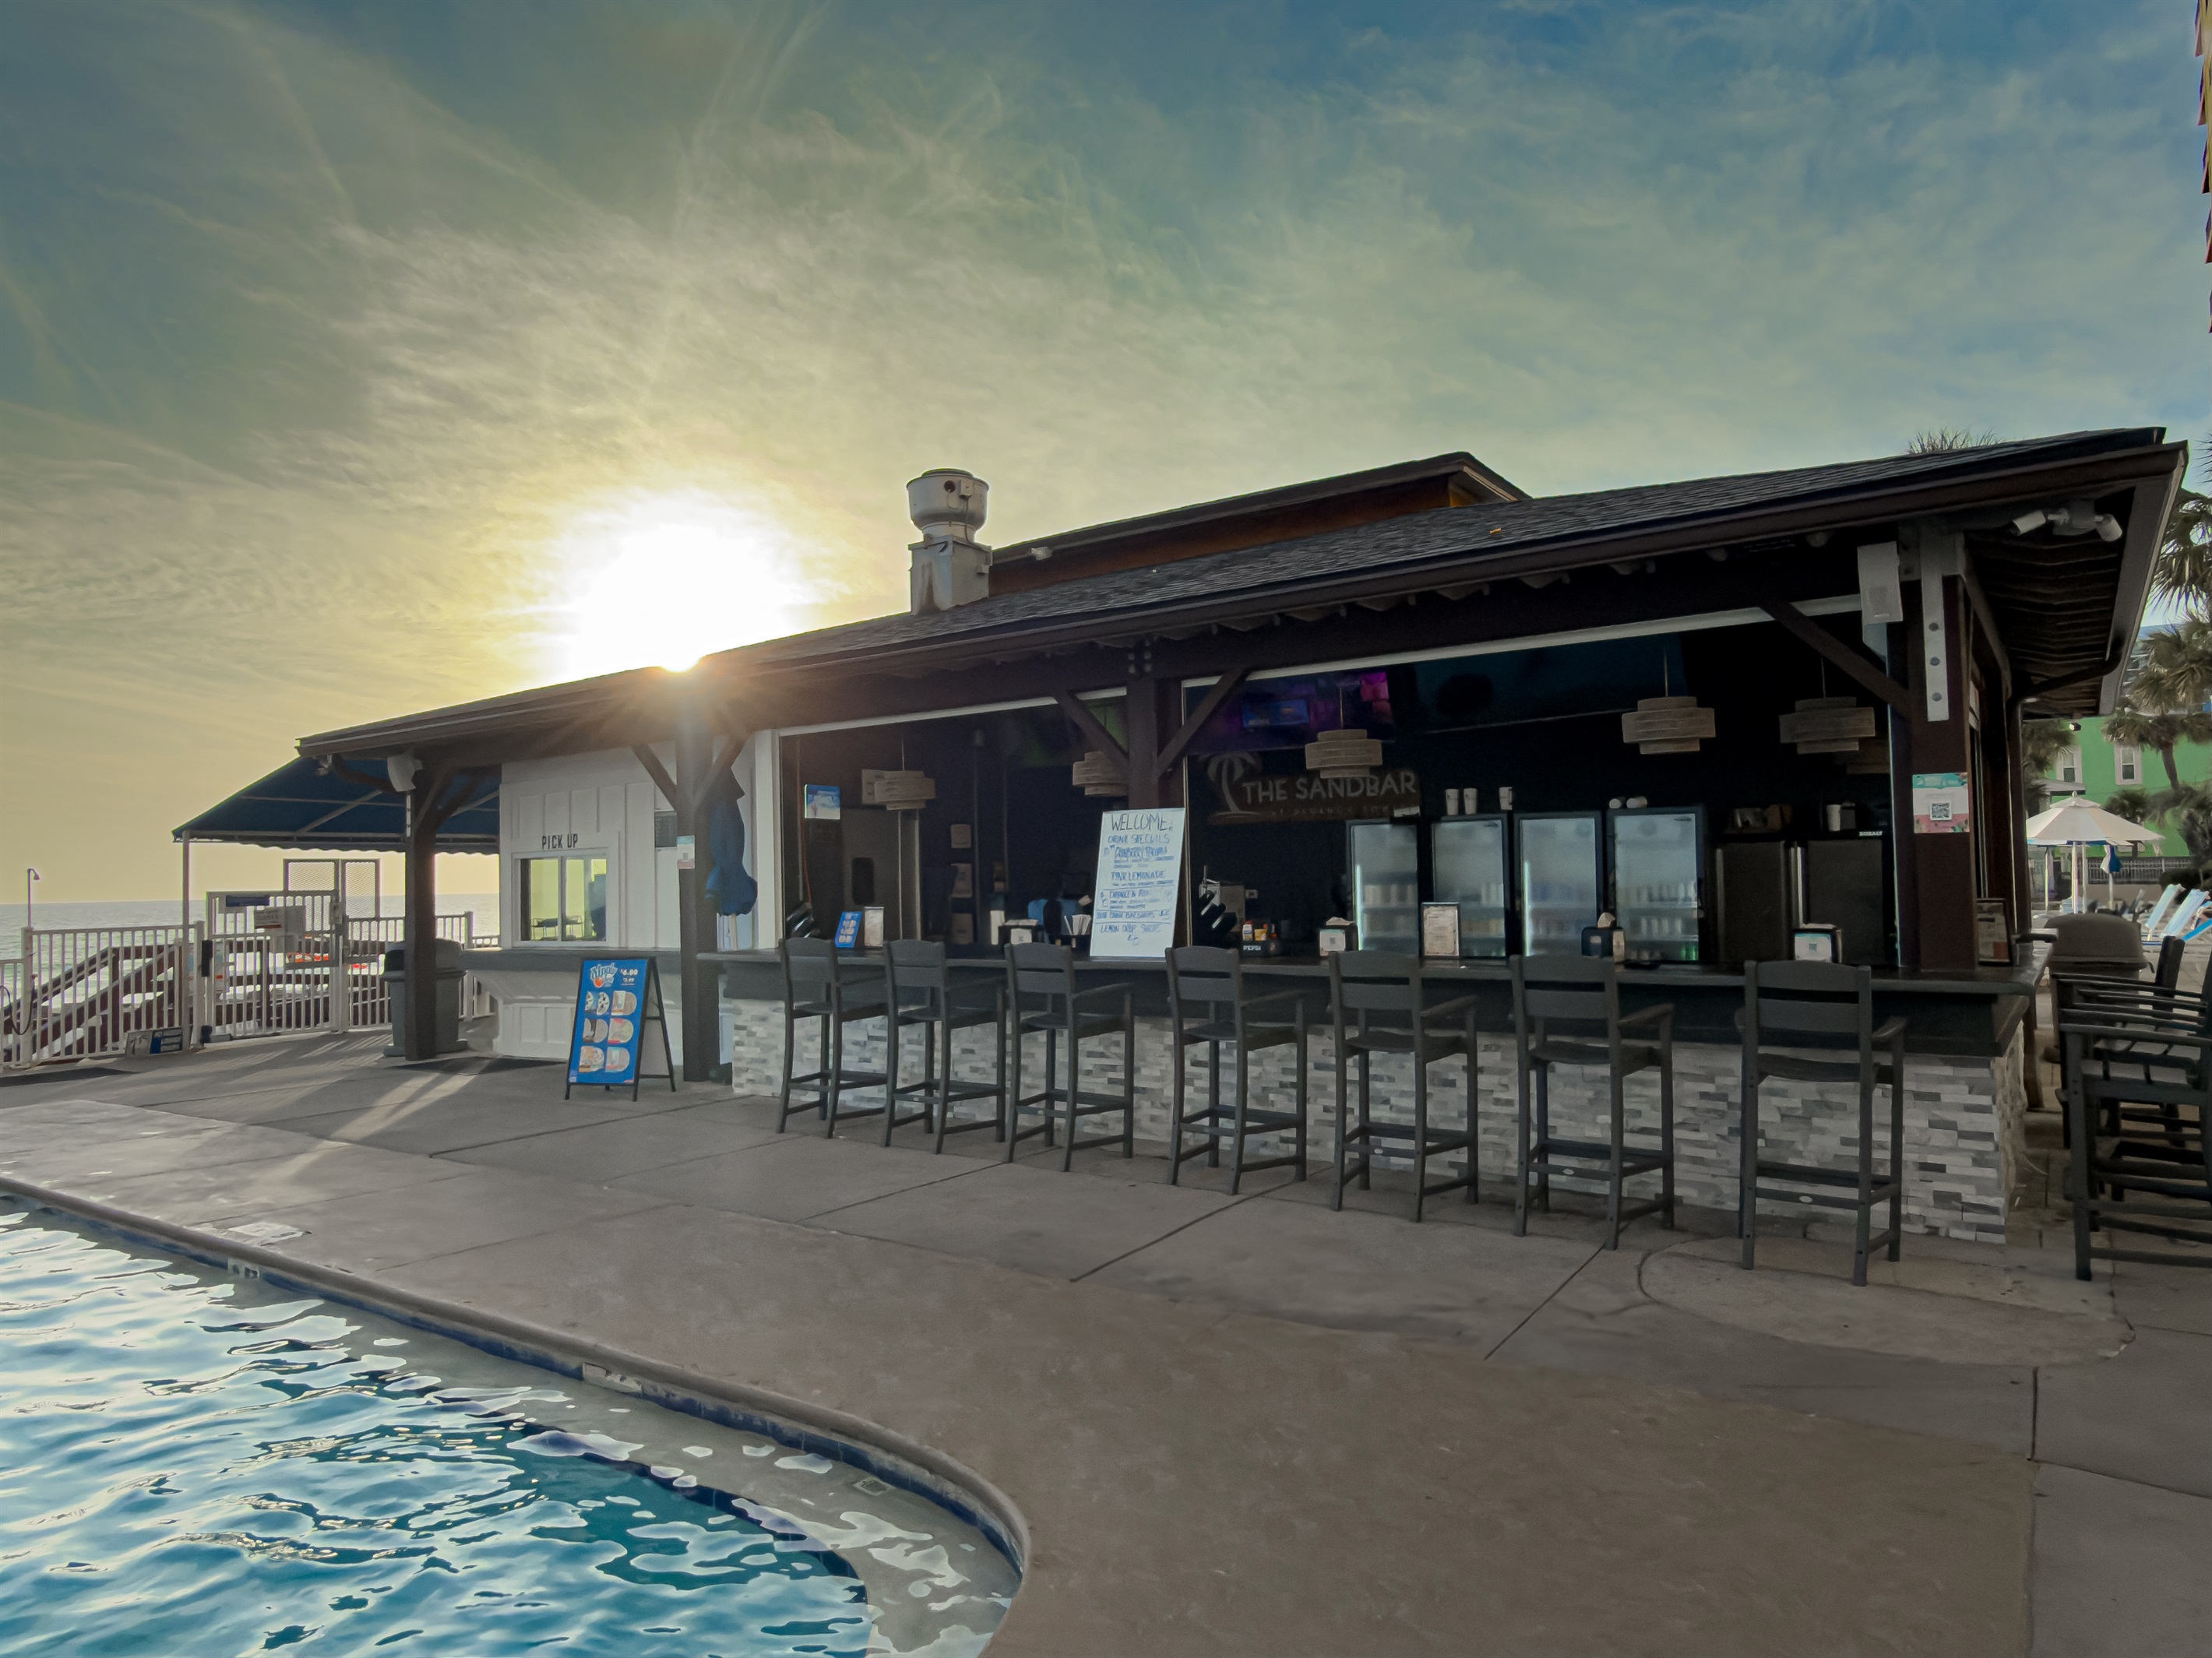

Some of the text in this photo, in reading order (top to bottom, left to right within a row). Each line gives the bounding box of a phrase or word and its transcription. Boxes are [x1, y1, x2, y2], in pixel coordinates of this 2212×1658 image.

[1242, 771, 1416, 804] THE SANDBAR
[542, 833, 578, 850] PICK UP
[1108, 834, 1128, 843] DRINK
